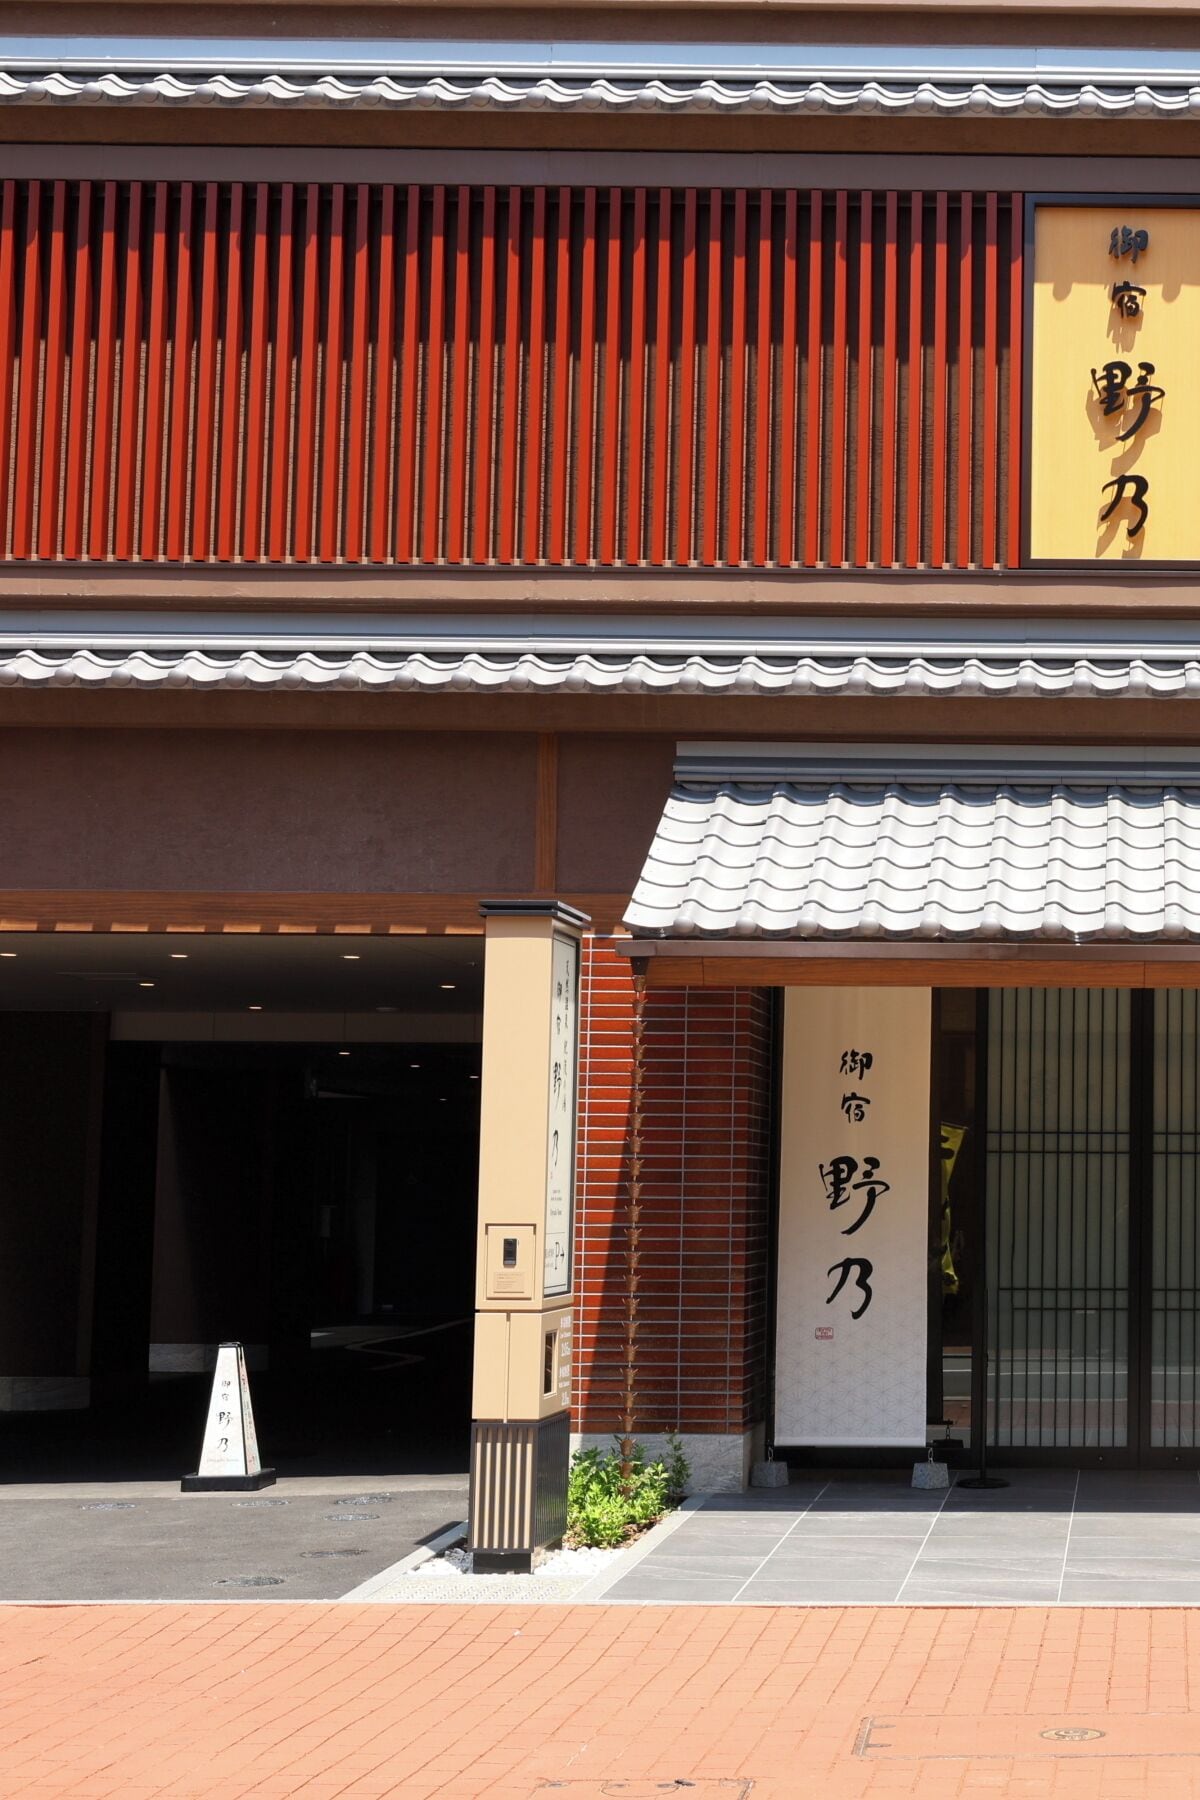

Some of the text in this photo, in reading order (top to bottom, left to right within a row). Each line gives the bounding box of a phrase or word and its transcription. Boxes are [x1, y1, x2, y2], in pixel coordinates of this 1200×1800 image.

[1091, 225, 1166, 538] 御宿野乃
[818, 1049, 891, 1320] 御宿野乃
